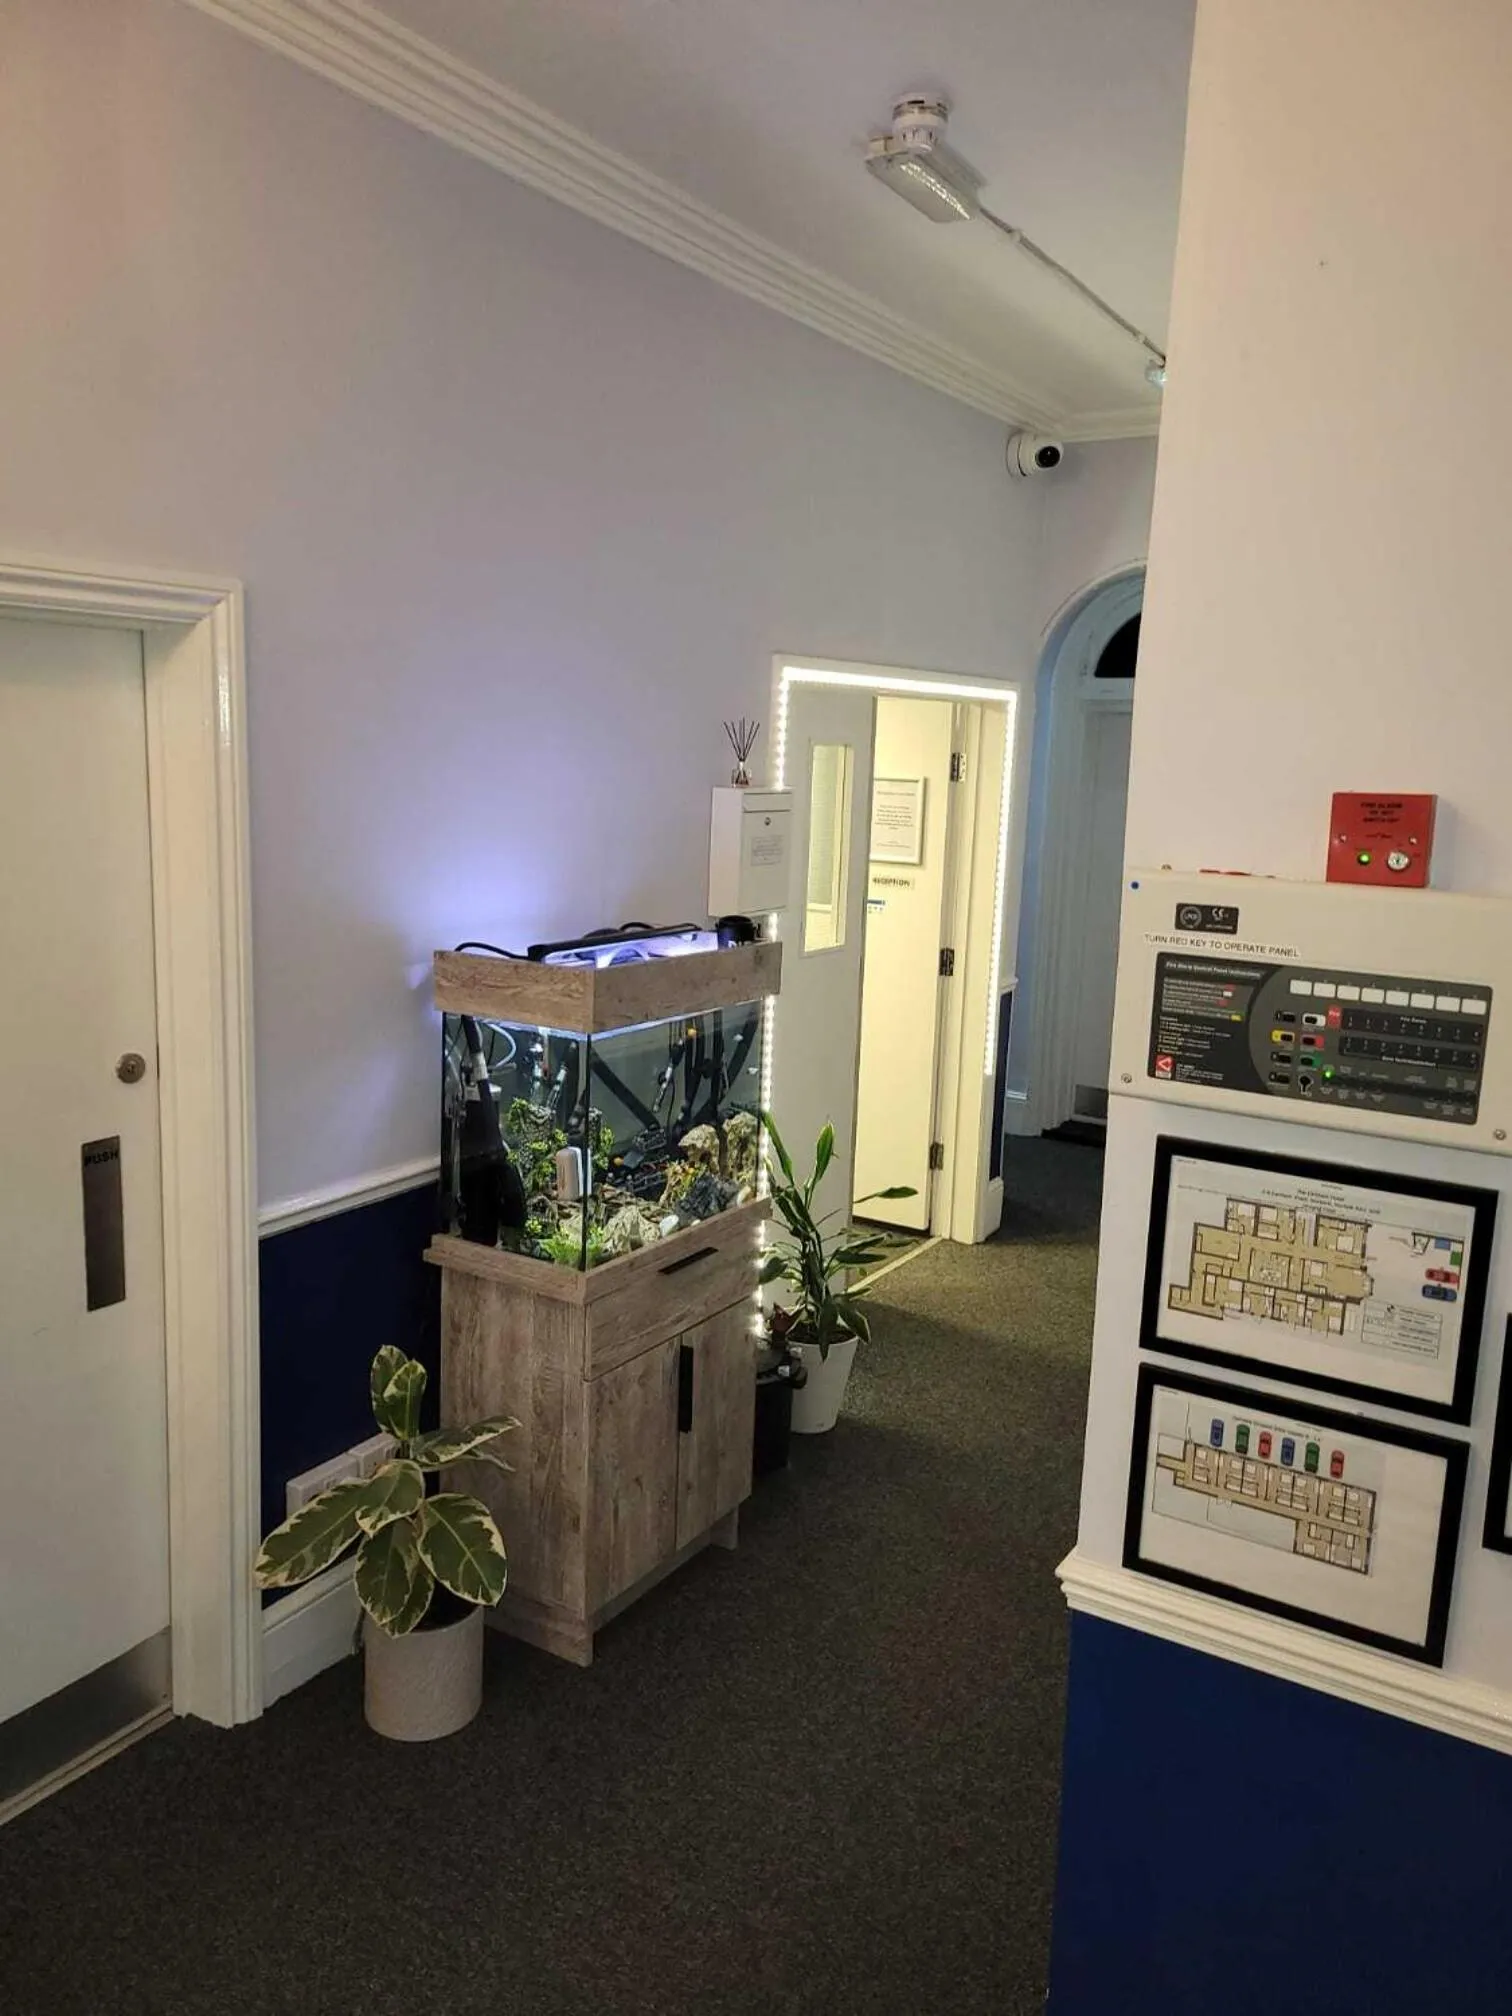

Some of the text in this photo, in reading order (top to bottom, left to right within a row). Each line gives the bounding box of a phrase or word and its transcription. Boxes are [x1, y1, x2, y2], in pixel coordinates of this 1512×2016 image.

[1144, 933, 1300, 958] TURN RED KEY TO OPERATE PANEL
[84, 1151, 119, 1167] PUSH
